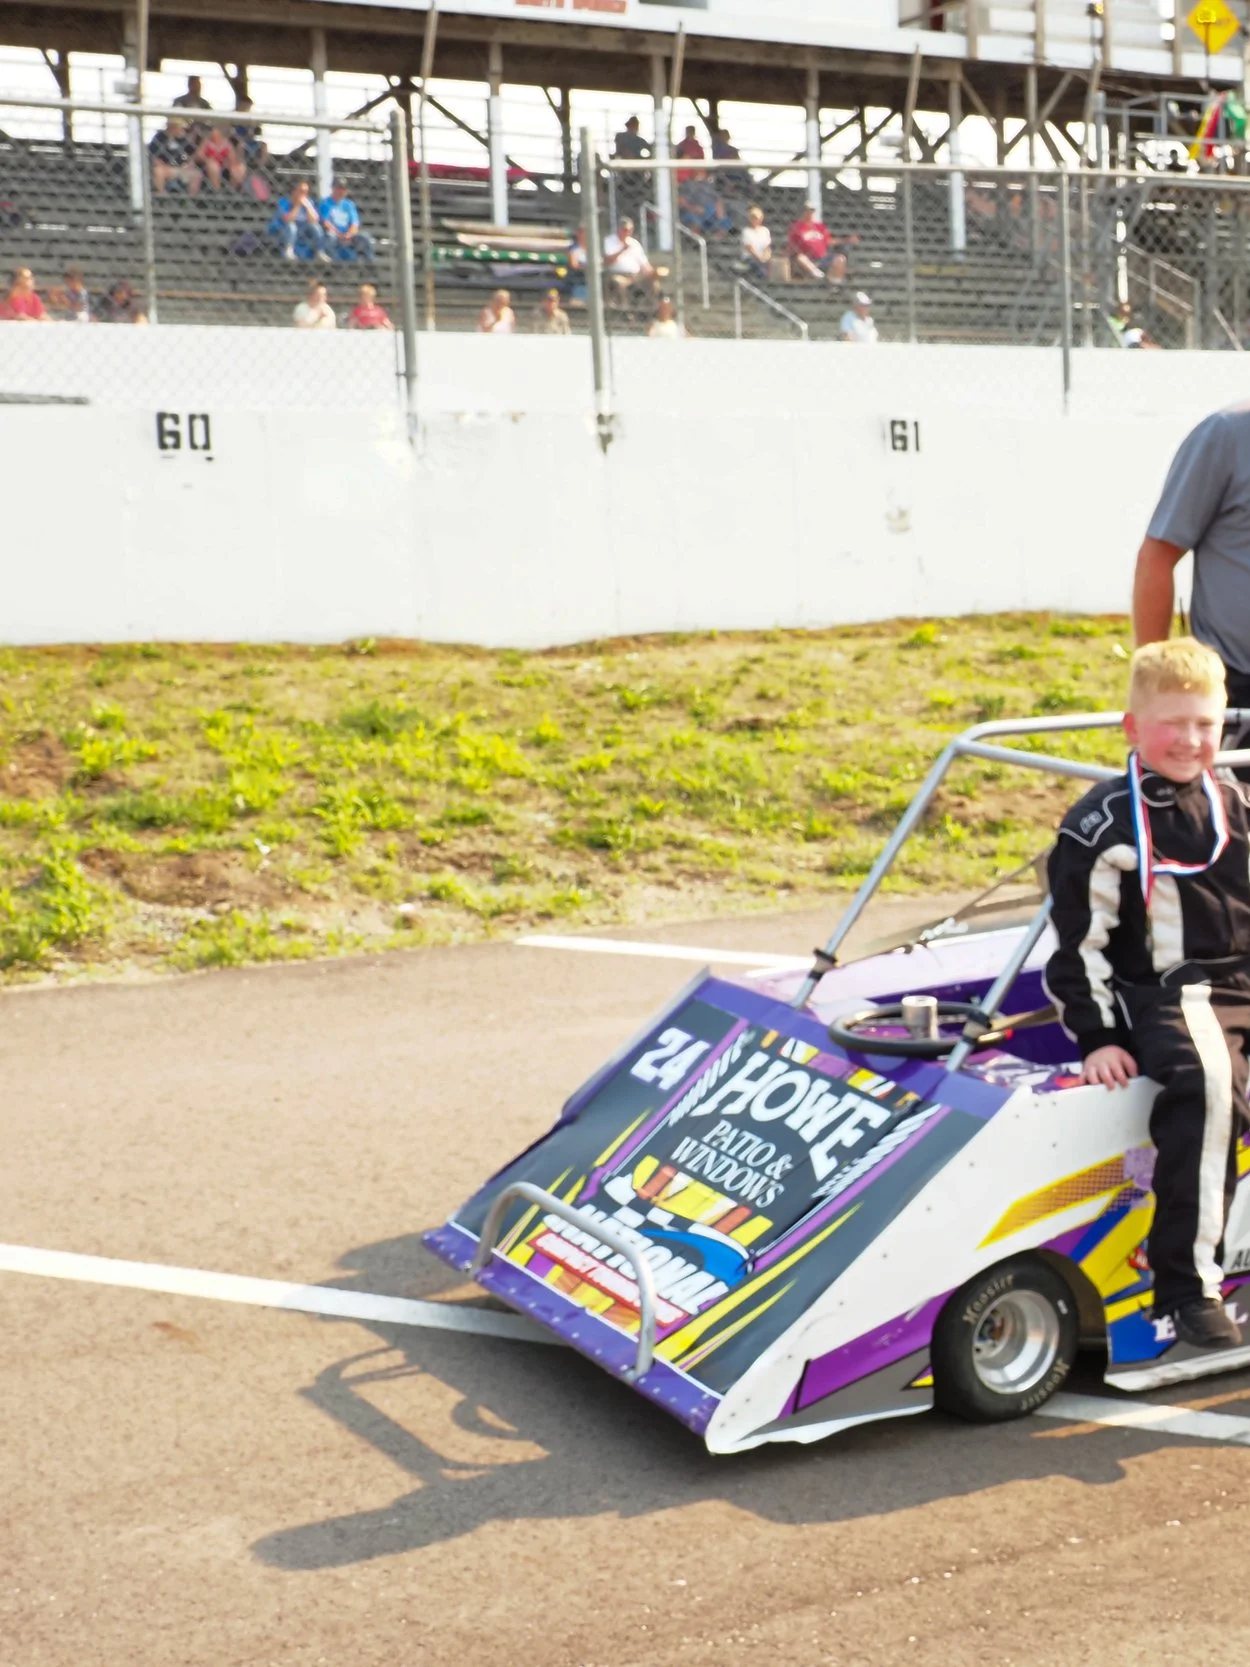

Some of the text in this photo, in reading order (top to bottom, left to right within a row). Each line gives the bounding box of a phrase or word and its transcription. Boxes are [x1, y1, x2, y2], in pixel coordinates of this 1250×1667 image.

[156, 411, 211, 450] 60
[890, 419, 920, 452] 61
[630, 1027, 712, 1090] 24
[690, 1051, 891, 1181] HOWE
[670, 1136, 786, 1208] WINDOWS
[703, 1119, 795, 1181] PATIO &
